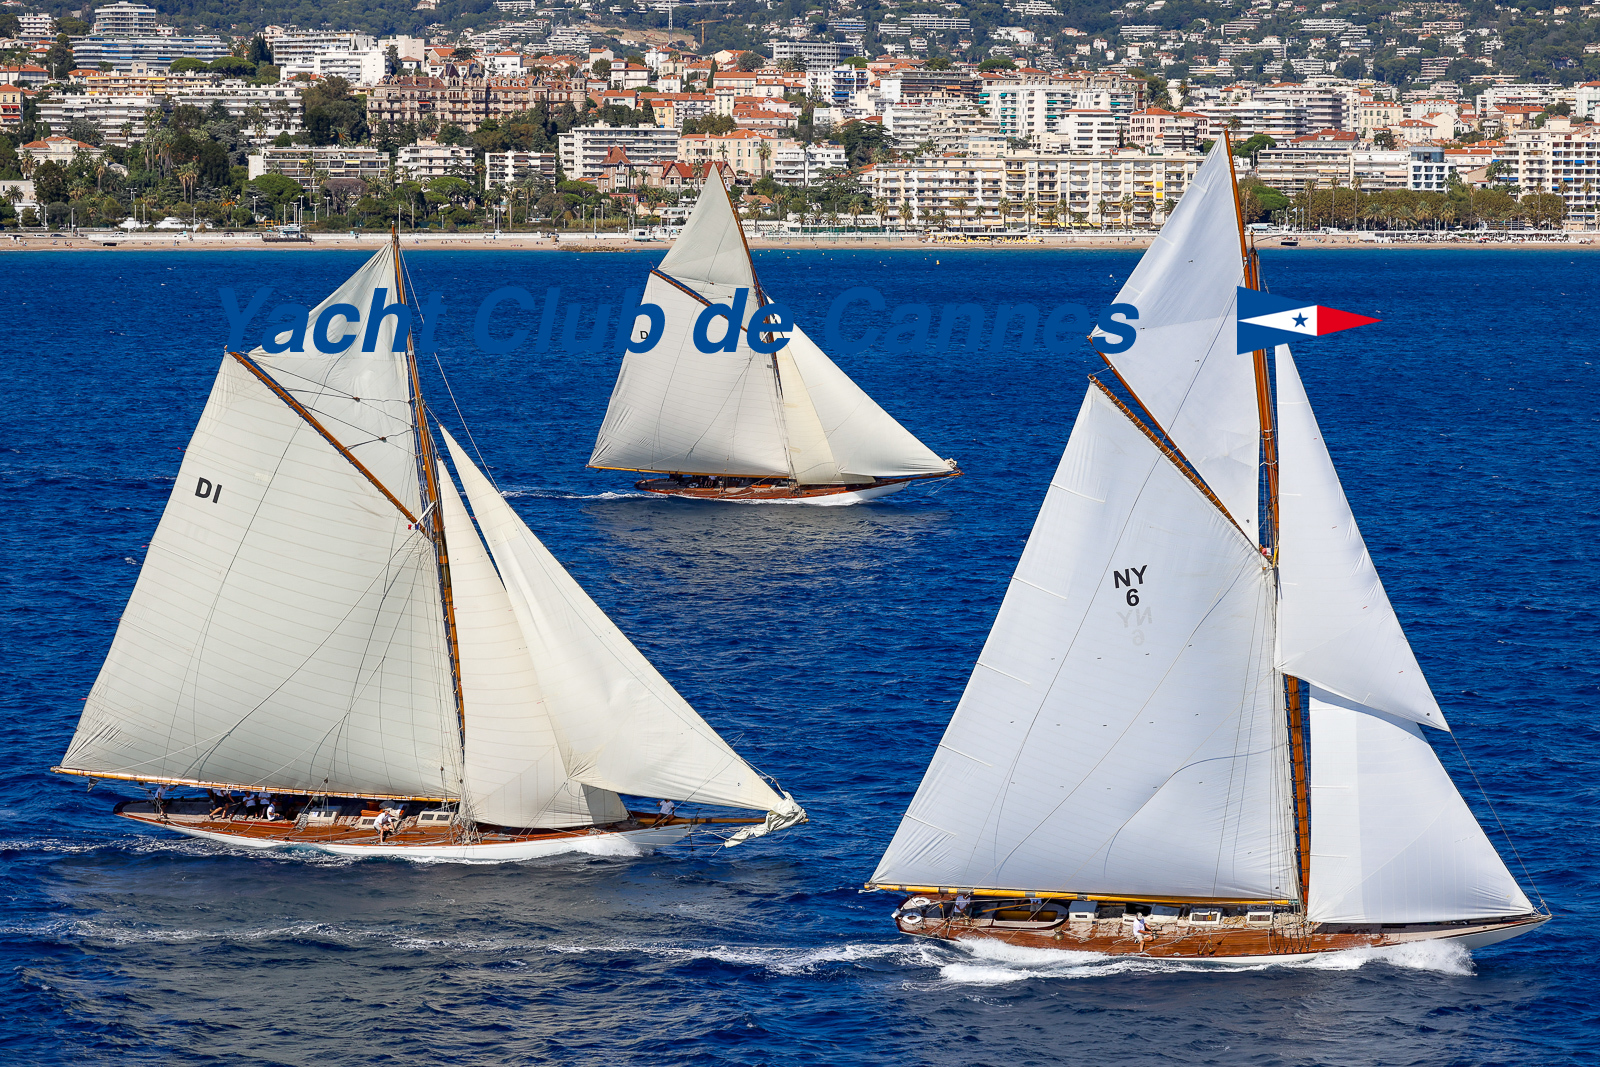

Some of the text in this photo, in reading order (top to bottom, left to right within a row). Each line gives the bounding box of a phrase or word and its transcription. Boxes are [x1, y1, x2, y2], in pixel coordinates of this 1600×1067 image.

[195, 476, 222, 504] DI
[1113, 564, 1148, 589] NY
[1125, 588, 1140, 607] 6
